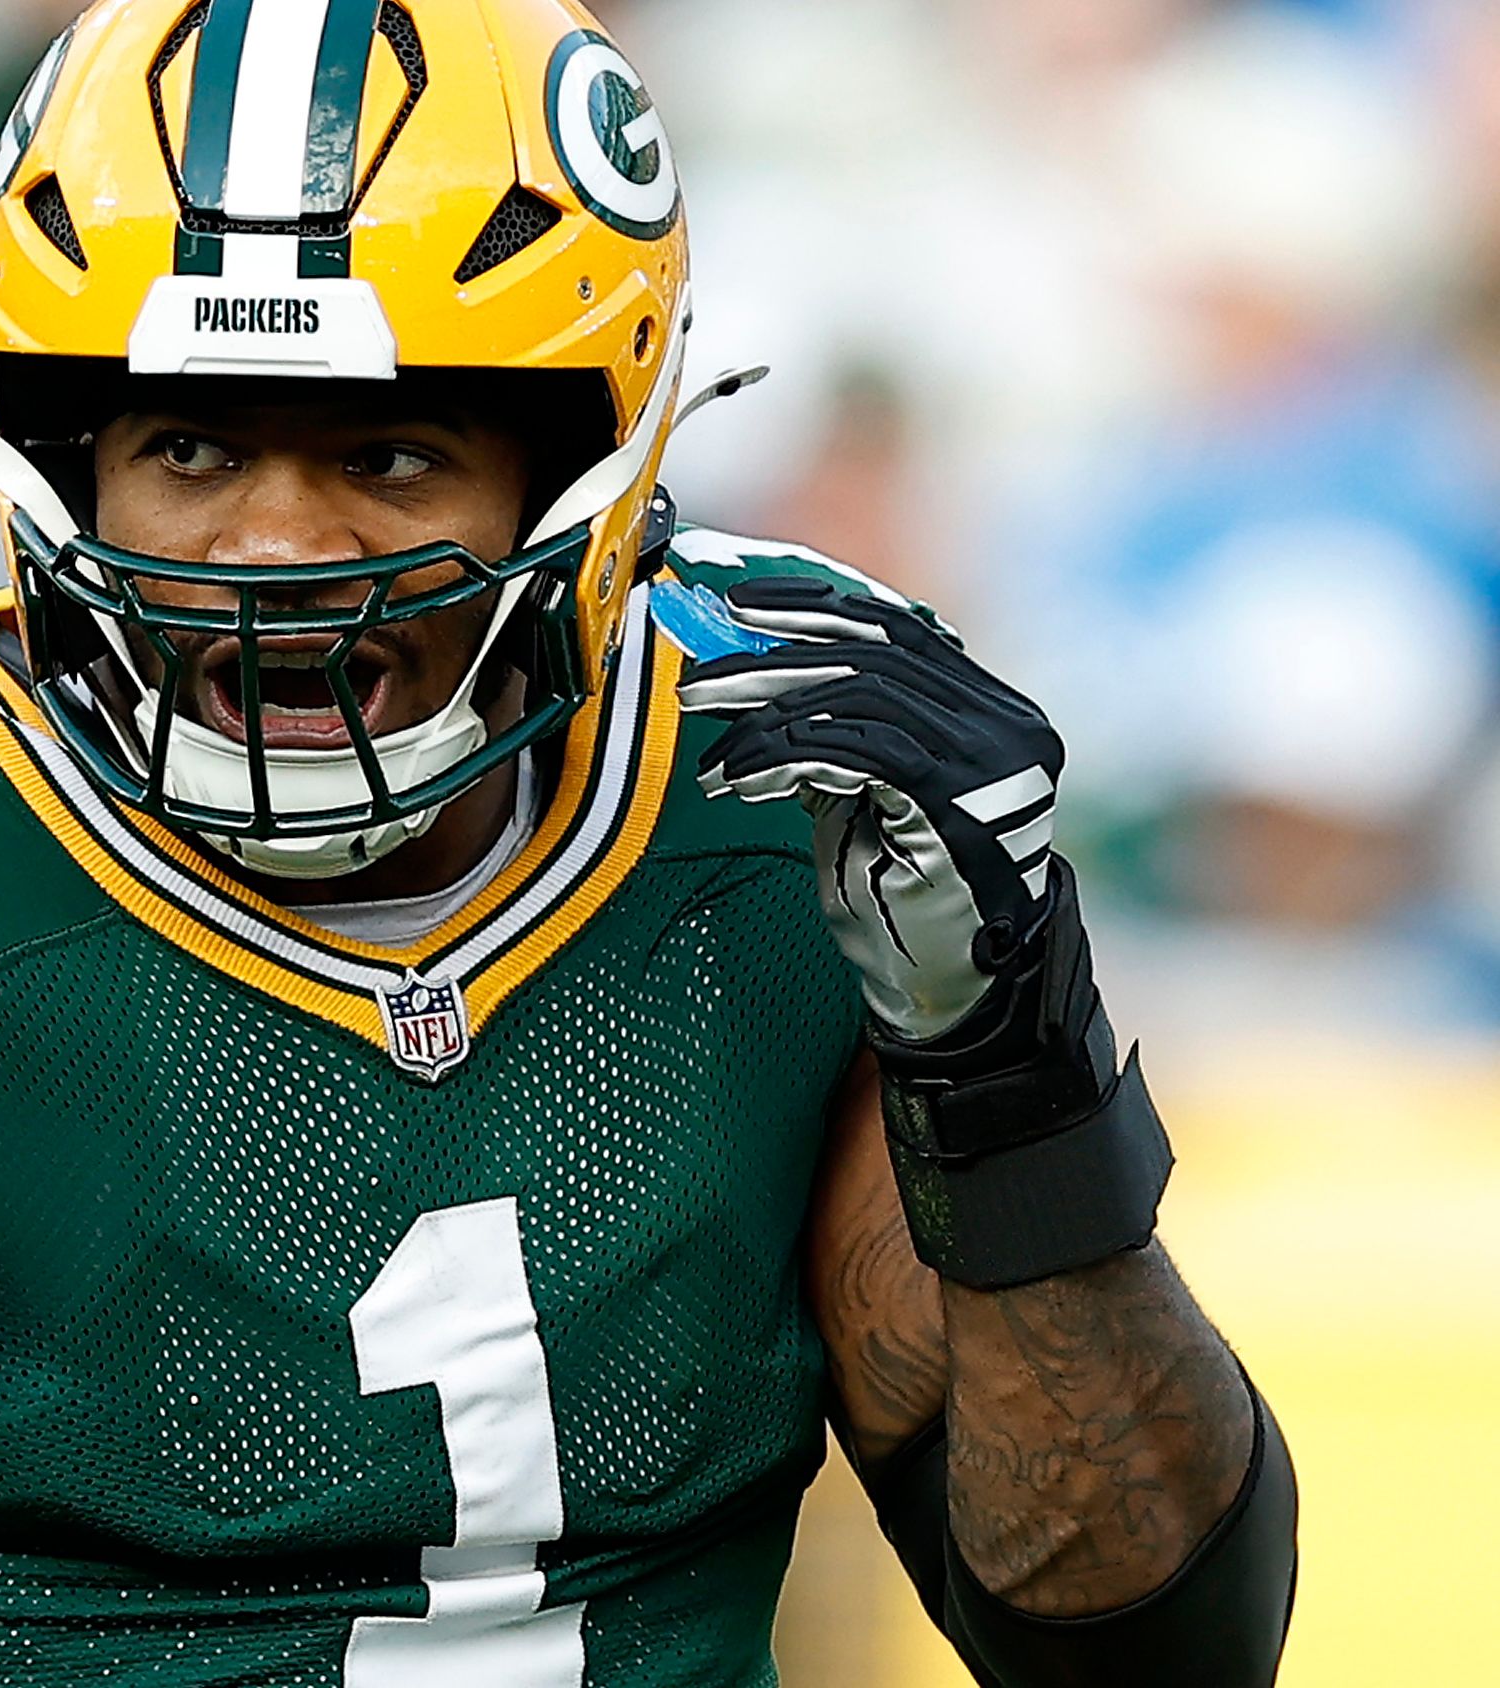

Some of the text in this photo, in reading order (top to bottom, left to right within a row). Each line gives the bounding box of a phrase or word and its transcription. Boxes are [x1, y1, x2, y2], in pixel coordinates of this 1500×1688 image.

[556, 43, 678, 223] G
[195, 297, 319, 334] PACKERS
[399, 1015, 458, 1060] NFL
[343, 1196, 588, 1688] 1
